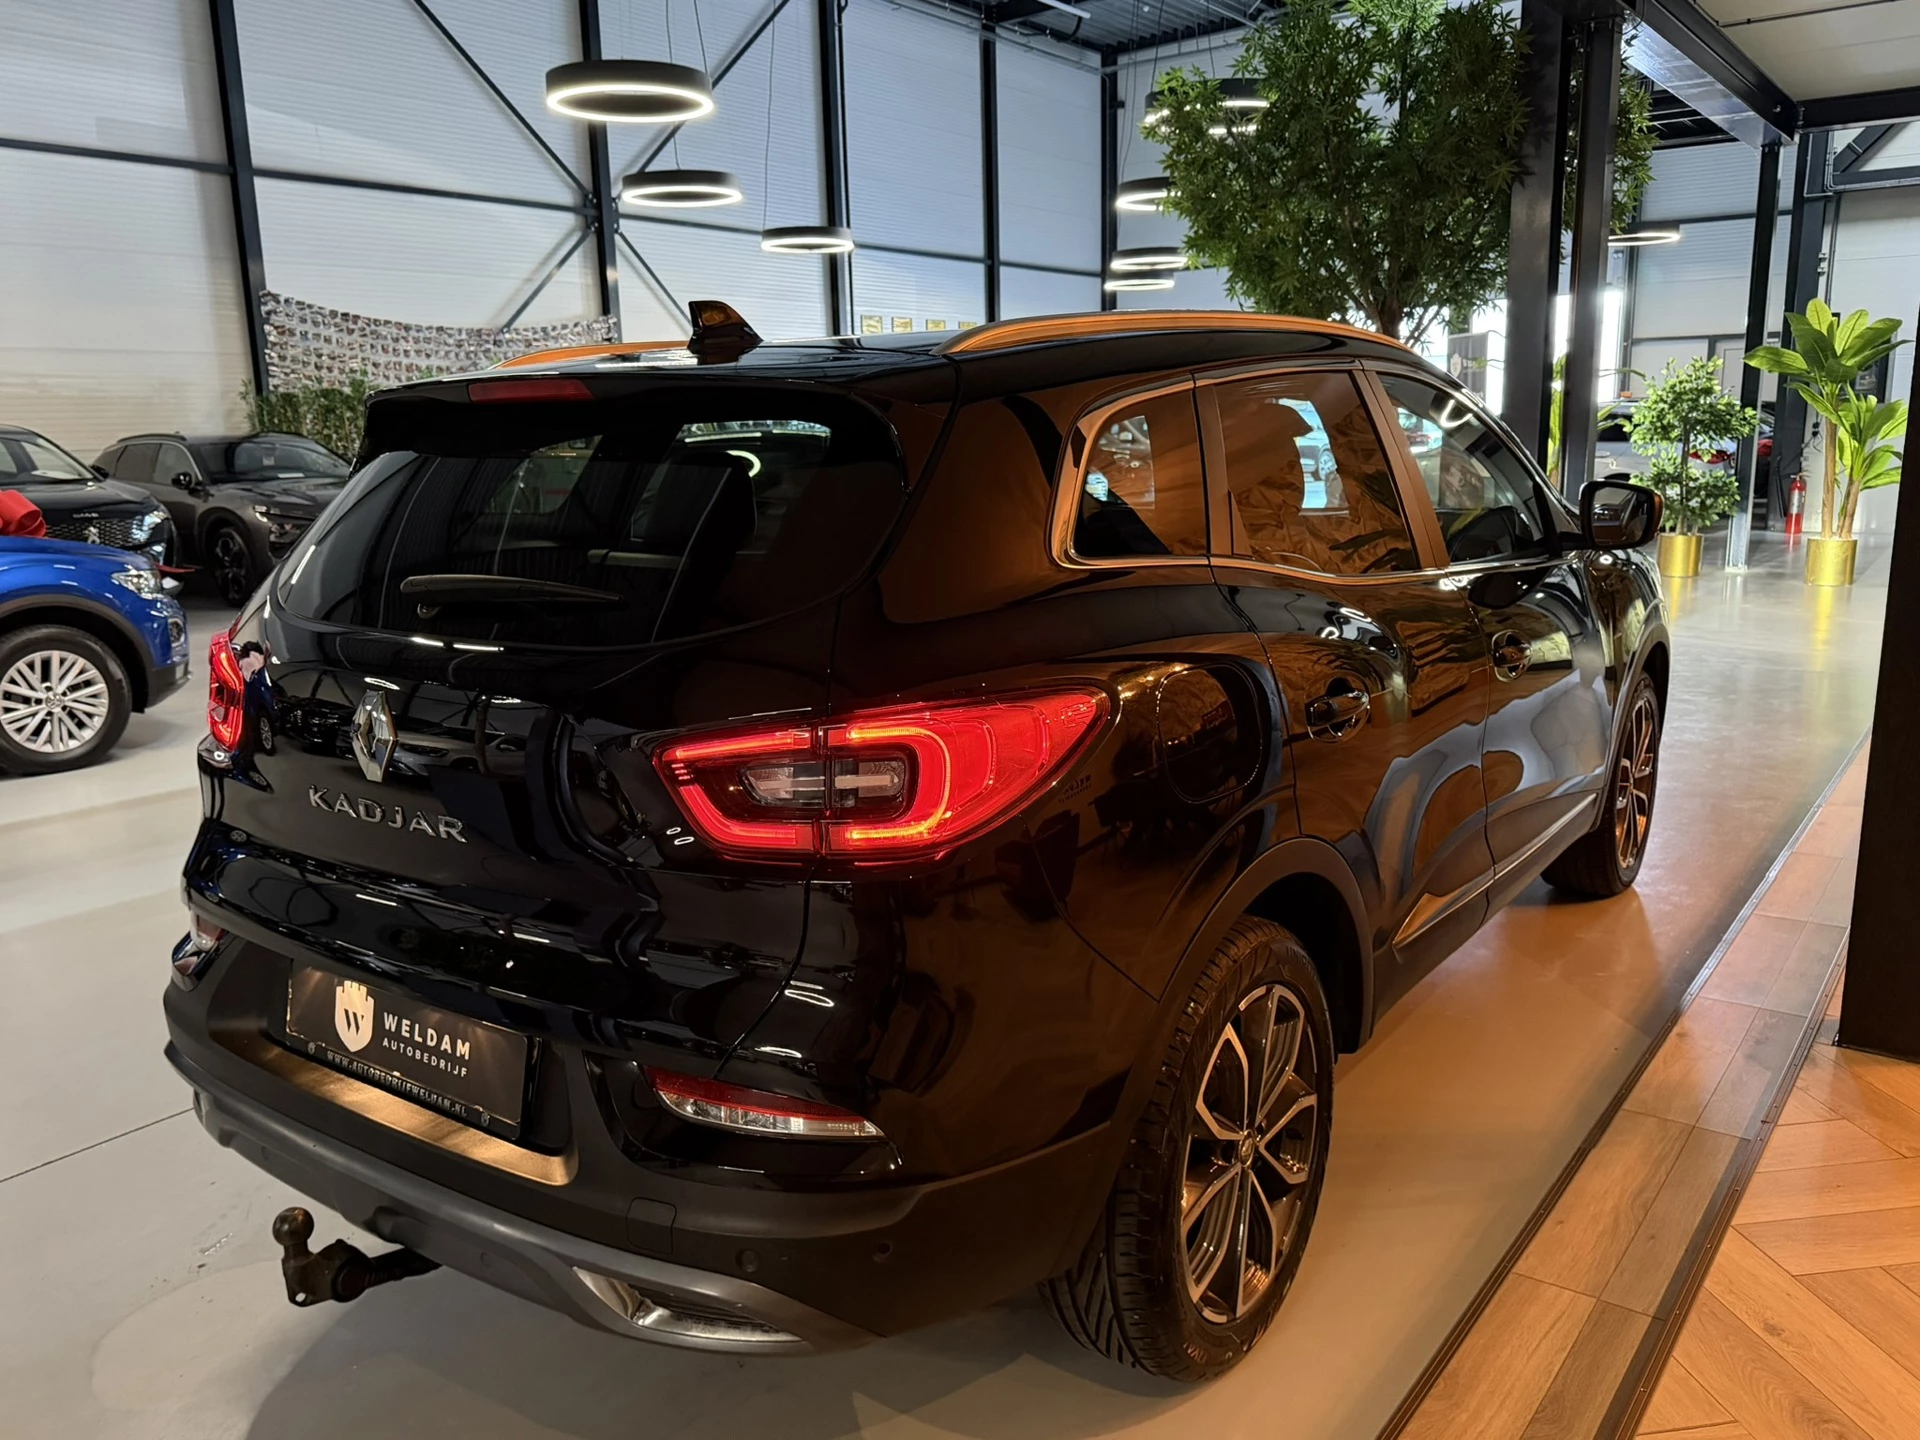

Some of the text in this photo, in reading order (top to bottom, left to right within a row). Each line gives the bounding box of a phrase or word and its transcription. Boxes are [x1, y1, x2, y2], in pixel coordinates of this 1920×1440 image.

[309, 785, 468, 843] KADJAR
[343, 1008, 365, 1036] W
[383, 1012, 471, 1060] WELDAM
[382, 1038, 468, 1078] AUTOBEDRIJF
